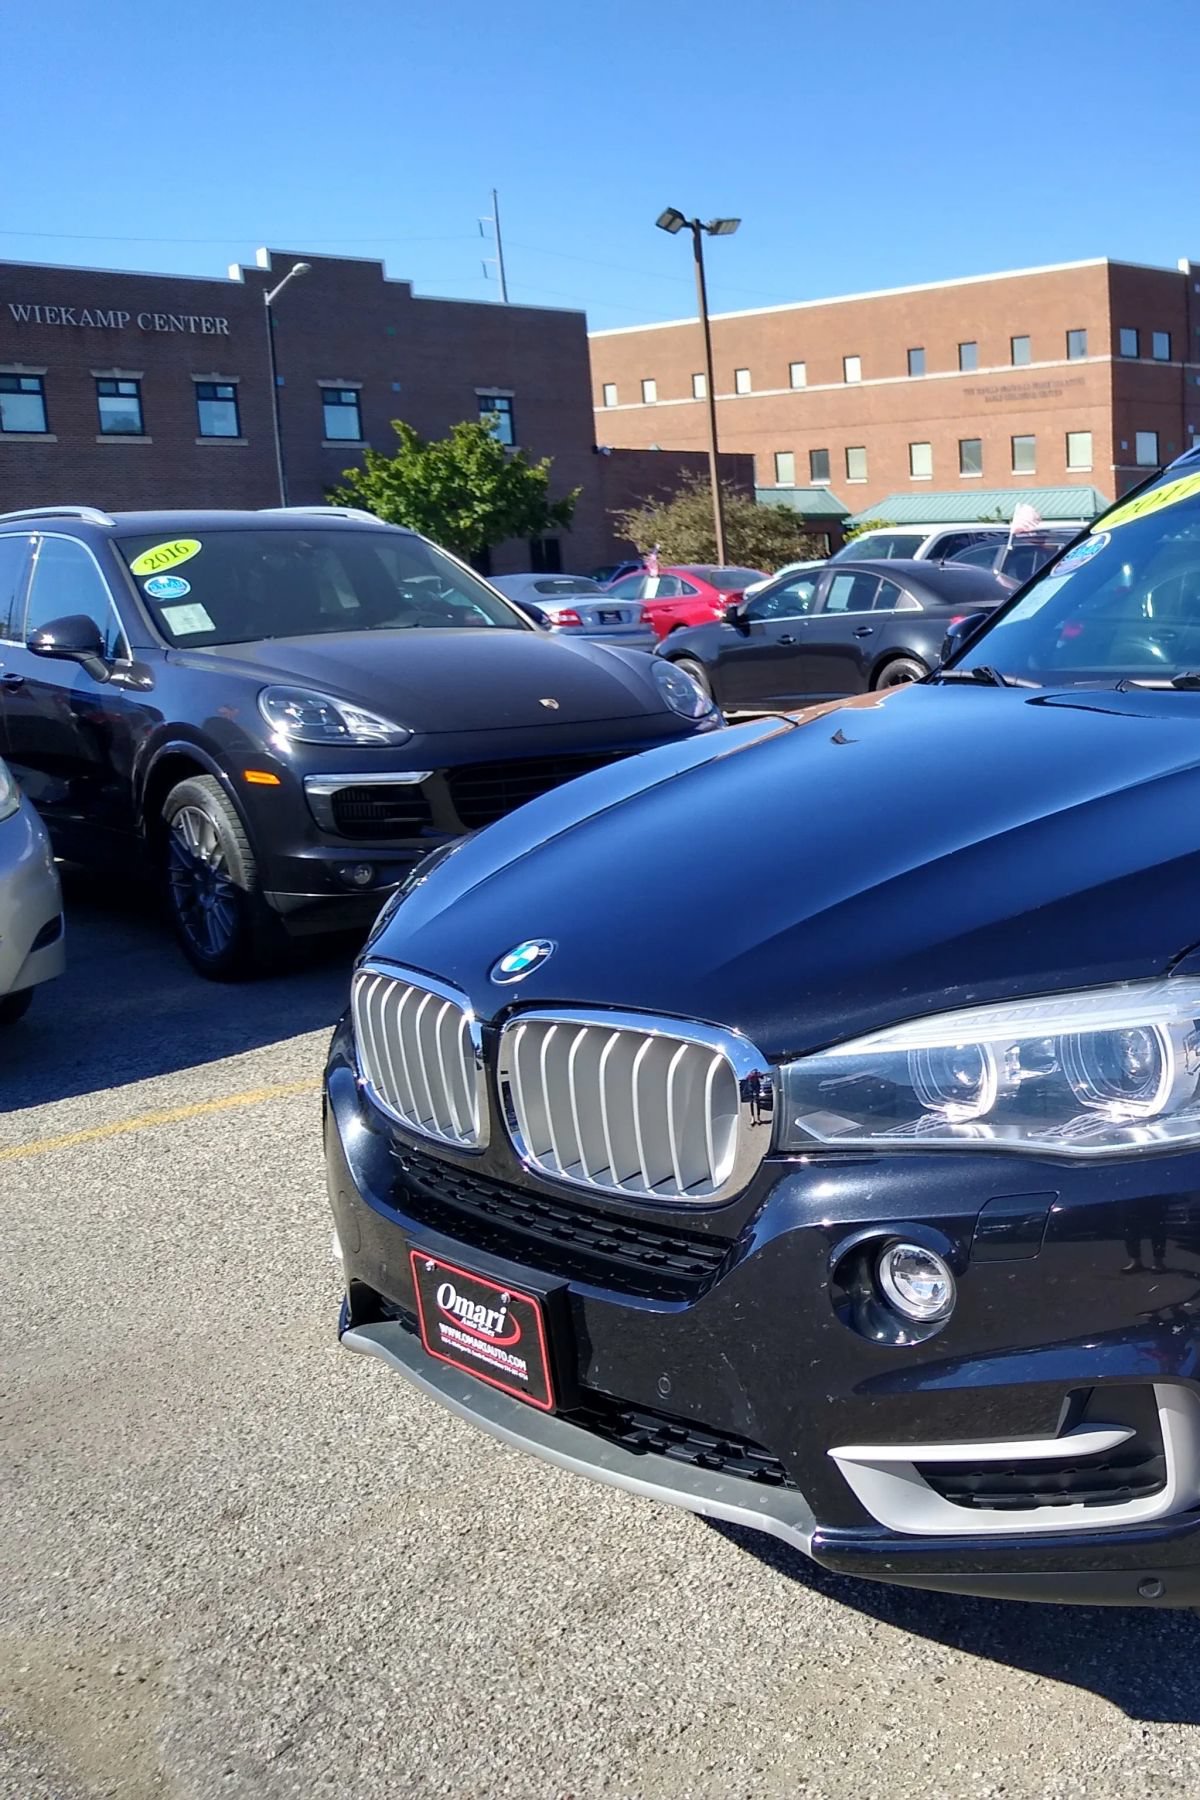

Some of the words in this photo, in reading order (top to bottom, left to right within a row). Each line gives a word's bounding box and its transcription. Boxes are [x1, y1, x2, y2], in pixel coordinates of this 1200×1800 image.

[8, 303, 131, 329] WIEKAMP
[137, 312, 230, 335] CENTER
[143, 543, 189, 570] 2016
[436, 1282, 507, 1334] Omari
